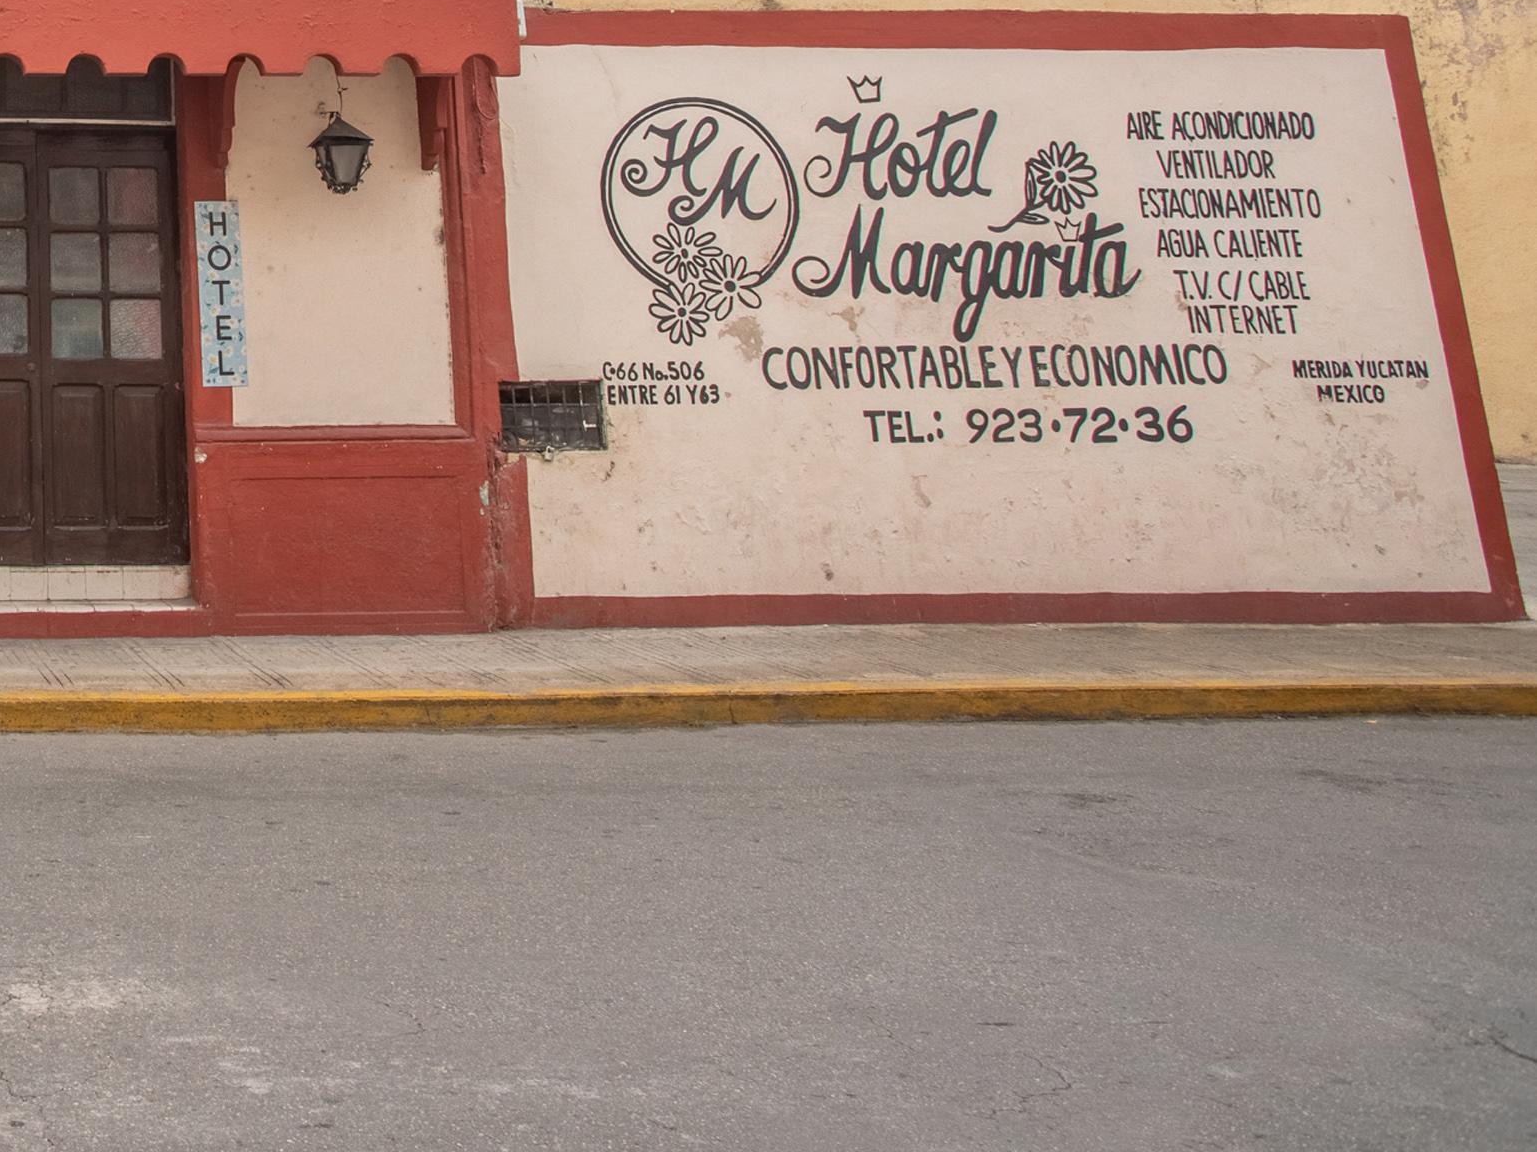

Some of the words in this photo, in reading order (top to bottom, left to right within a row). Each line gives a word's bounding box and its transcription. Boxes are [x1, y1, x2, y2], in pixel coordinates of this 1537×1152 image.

[1126, 110, 1165, 141] AIRE
[1171, 111, 1316, 141] ACONDICIONADO
[803, 108, 998, 200] Hotel
[1156, 150, 1276, 179] VENTILADOR
[1138, 188, 1321, 219] ESTACIONAMIENTO
[1157, 229, 1210, 258] AGUA
[1213, 229, 1303, 258] CALIENTE
[792, 203, 1142, 343] Margarita
[207, 211, 235, 377] HOTEL
[1187, 305, 1298, 335] INTERNET
[1029, 343, 1229, 388] ECONOMICO
[1292, 359, 1353, 379] MERIDA
[1356, 359, 1429, 379] YUCATAN
[607, 384, 659, 406] ENTRE
[664, 385, 682, 405] 61
[1317, 384, 1385, 404] MEXICO
